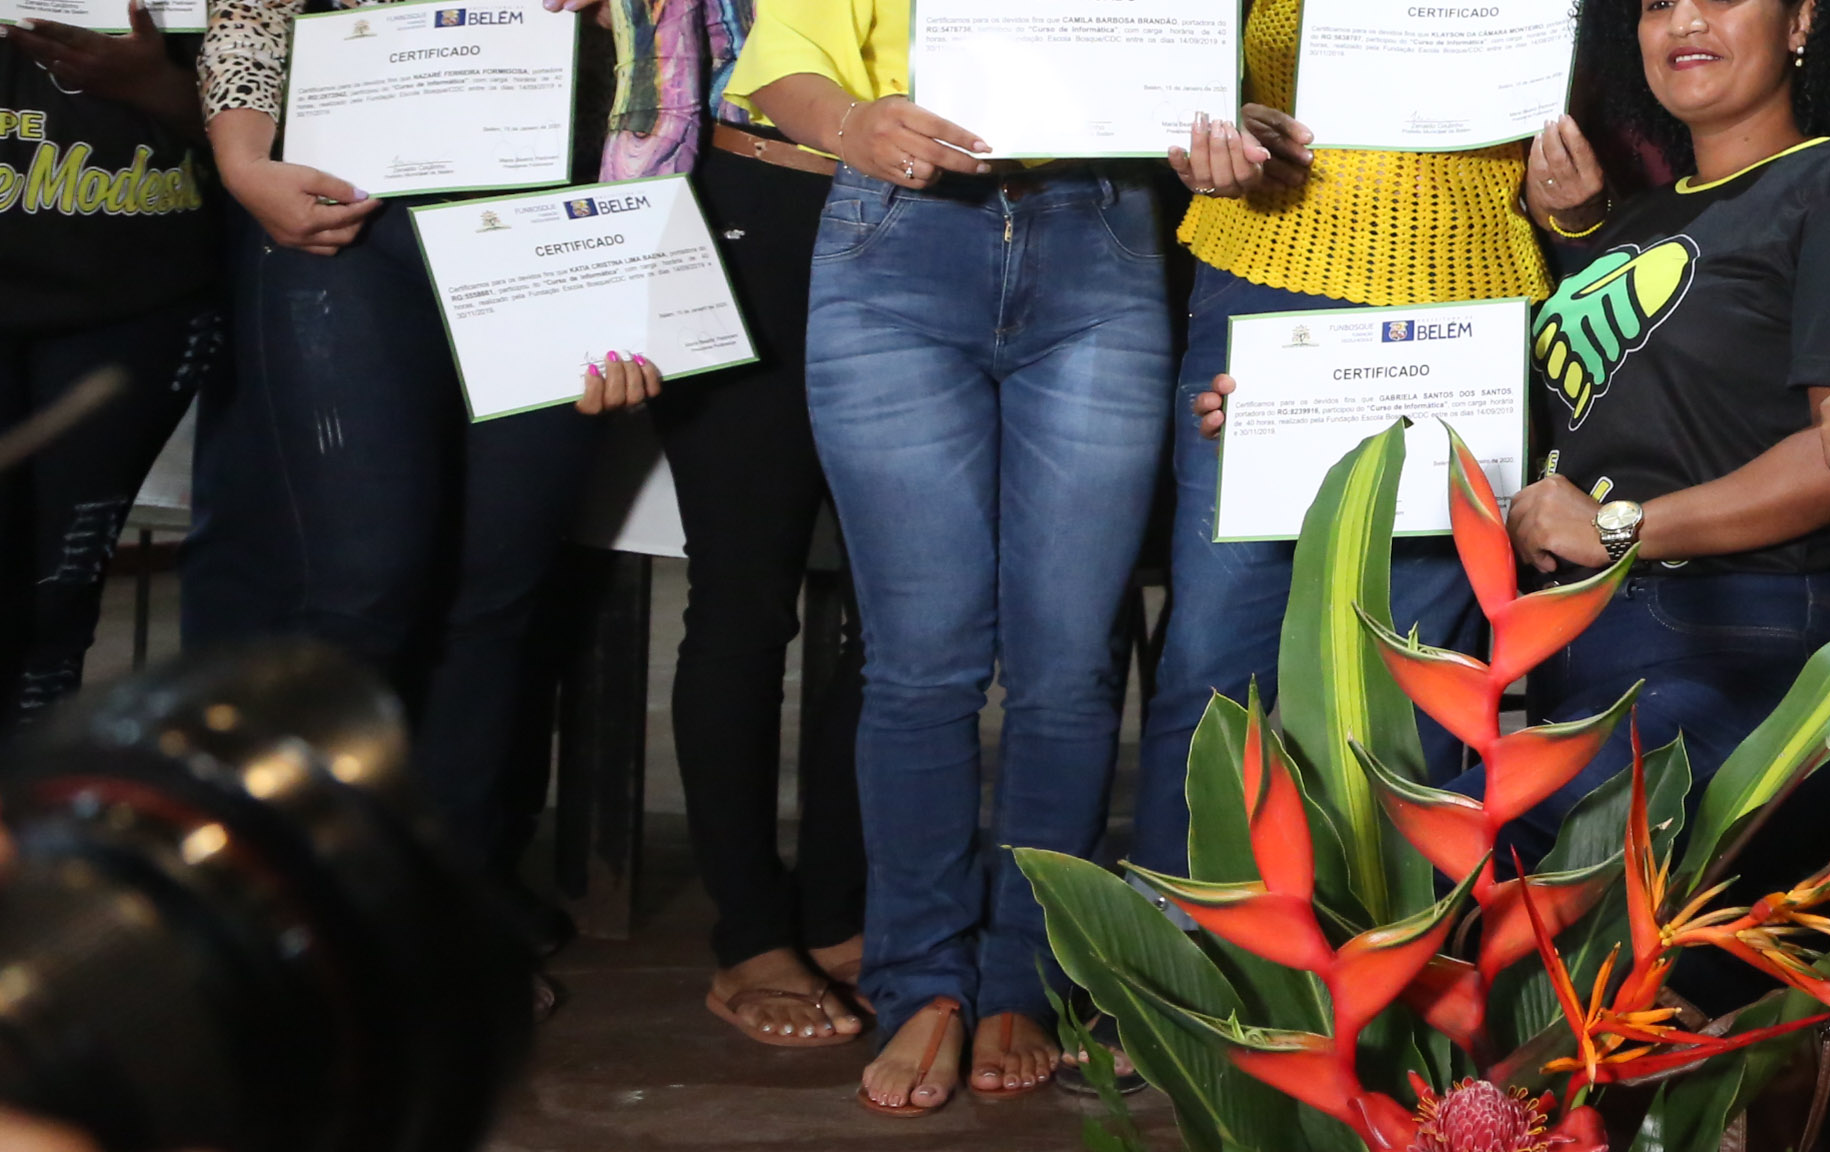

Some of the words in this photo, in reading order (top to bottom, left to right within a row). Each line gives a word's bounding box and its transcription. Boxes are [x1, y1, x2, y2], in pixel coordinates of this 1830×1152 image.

[467, 10, 523, 25] BELÉM
[1062, 16, 1093, 24] CAMILA
[1095, 16, 1135, 24] BARBOSA
[1407, 6, 1499, 18] CERTIFICADO
[388, 44, 480, 63] CERTIFICADO
[597, 195, 650, 215] BELÉM
[534, 233, 624, 257] CERTIFICADO
[1416, 321, 1472, 340] BELÉM
[1332, 364, 1429, 380] CERTIFICADO
[1378, 393, 1417, 401] GABRIELA
[1423, 391, 1453, 399] SANTOS
[1458, 389, 1475, 397] DOS
